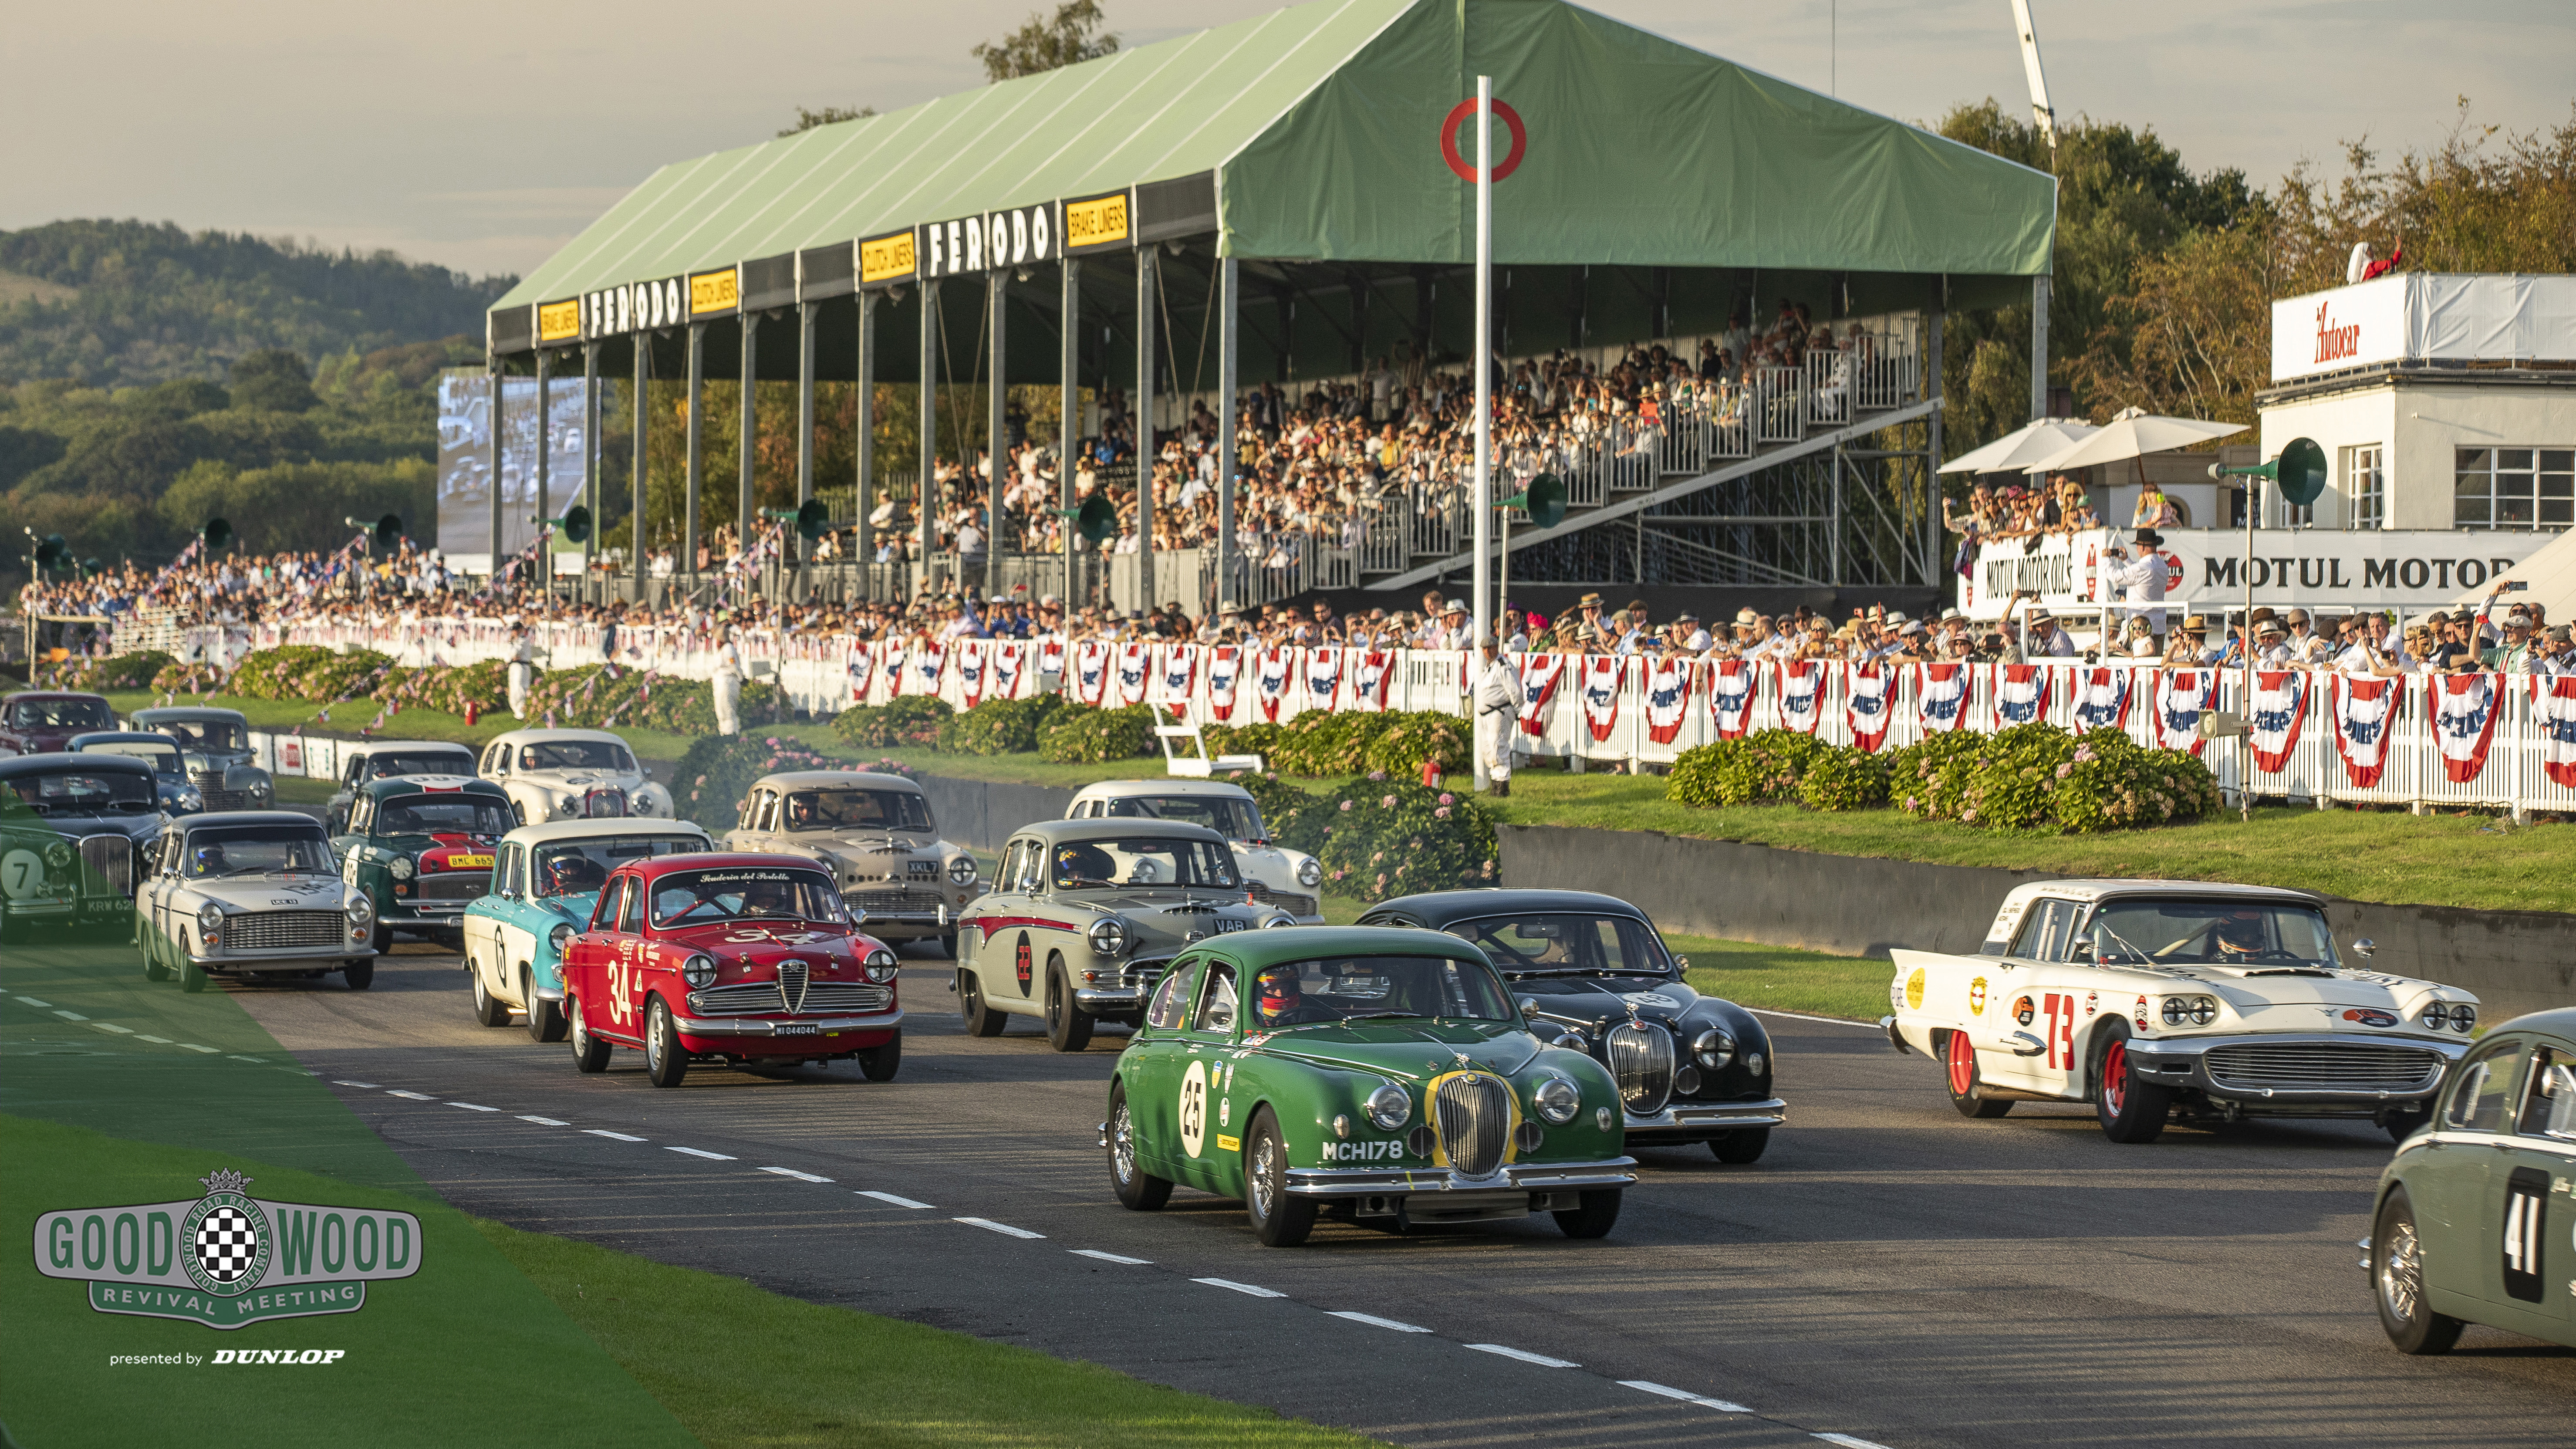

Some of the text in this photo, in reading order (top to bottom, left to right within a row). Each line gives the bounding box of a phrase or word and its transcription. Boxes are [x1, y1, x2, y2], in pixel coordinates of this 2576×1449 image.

[1071, 204, 1123, 238] BRAKE LINERS
[865, 242, 911, 273] CLUTCH LINERS
[929, 206, 1049, 277] FERODO
[591, 278, 679, 338] FERODO
[2314, 301, 2360, 364] Autocar
[1987, 553, 2072, 599] MOTUL MOTOR OILS
[2204, 557, 2350, 588] MOTUL
[14, 863, 29, 889] 7
[452, 857, 493, 865] BMC 665
[88, 900, 112, 912] KRW
[725, 929, 815, 945] 34
[1215, 920, 1245, 932] VAB
[1018, 946, 1030, 980] 22
[608, 959, 632, 1027] 34
[1636, 994, 1673, 1004] 48
[2044, 993, 2074, 1071] 73
[1184, 1079, 1202, 1138] 25
[2504, 1192, 2540, 1276] 41
